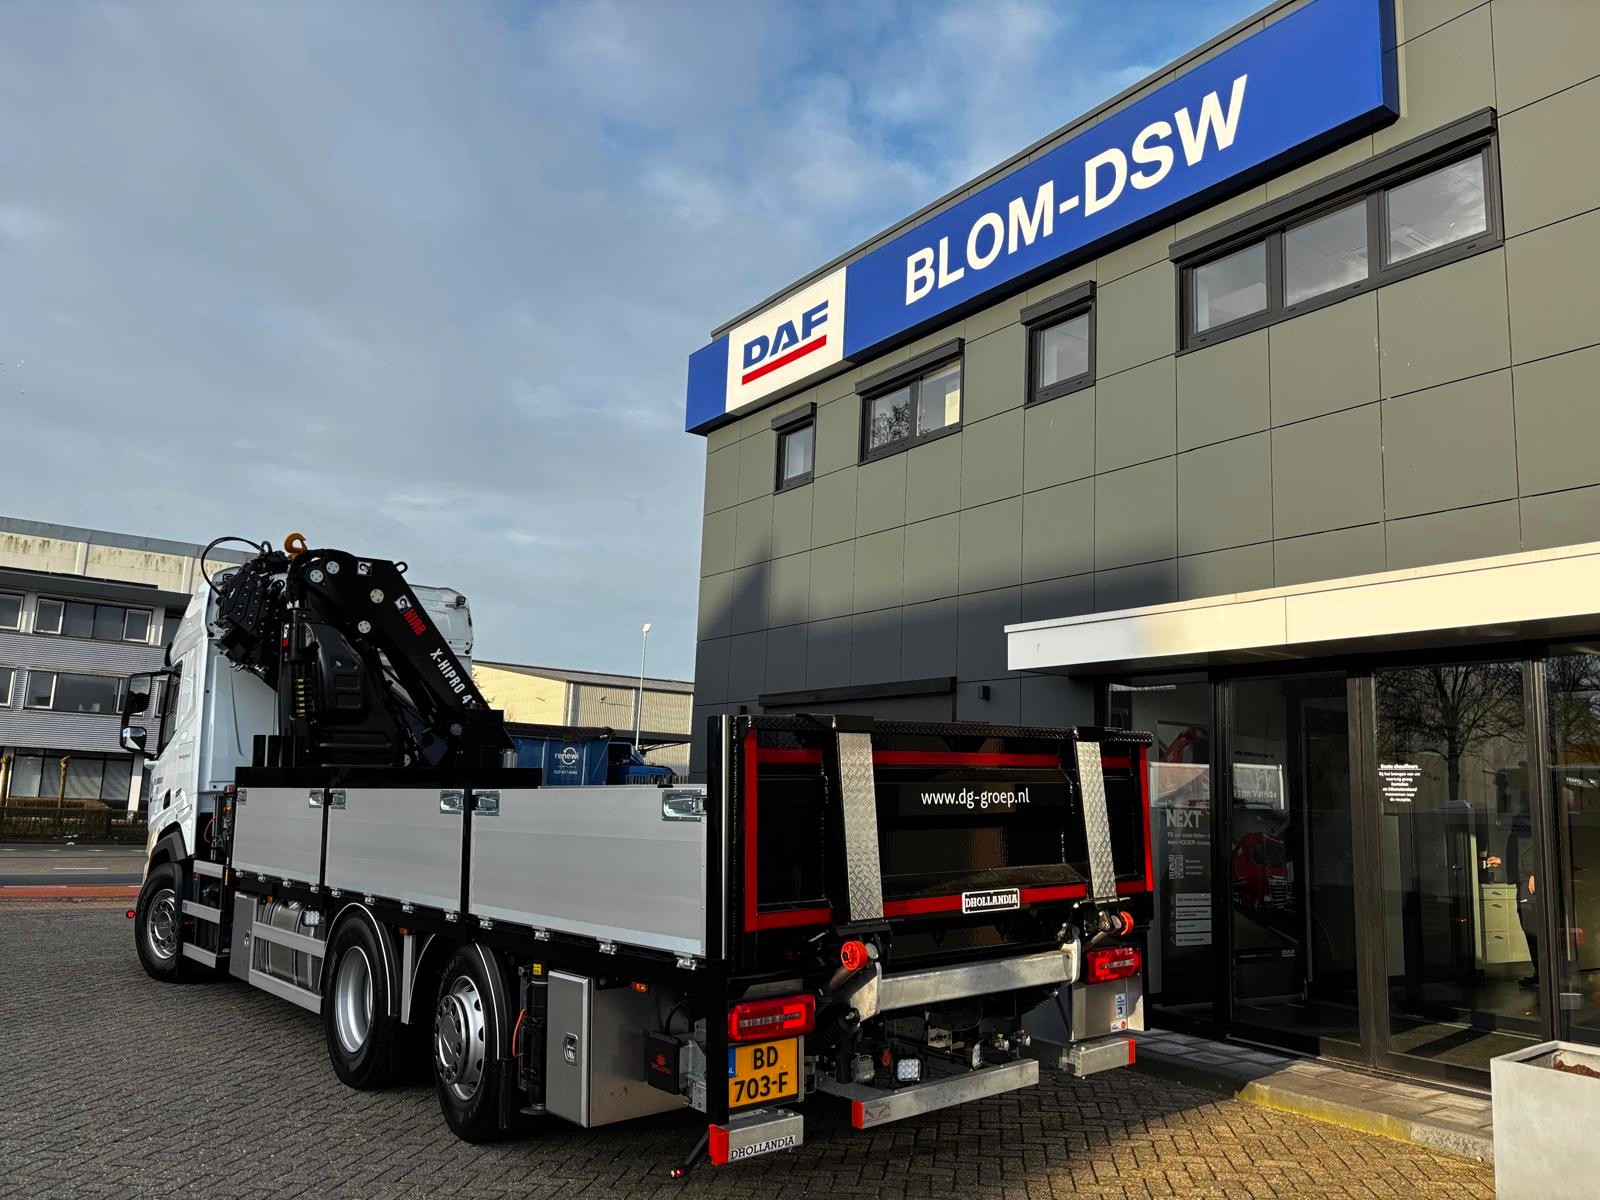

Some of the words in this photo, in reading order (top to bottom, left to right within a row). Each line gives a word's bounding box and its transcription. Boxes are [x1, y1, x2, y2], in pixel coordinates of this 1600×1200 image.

[905, 73, 1248, 306] BLOM-DSW
[742, 299, 829, 370] DAF
[430, 648, 466, 694] X-HIPRO
[920, 787, 1031, 809] www.dg-groep.nl
[1166, 808, 1201, 828] NEXT
[965, 893, 1019, 908] DHOLLANDIA
[753, 1045, 779, 1071] BD
[734, 1071, 789, 1103] 703-F
[730, 1135, 795, 1160] DHOLLANDIA
